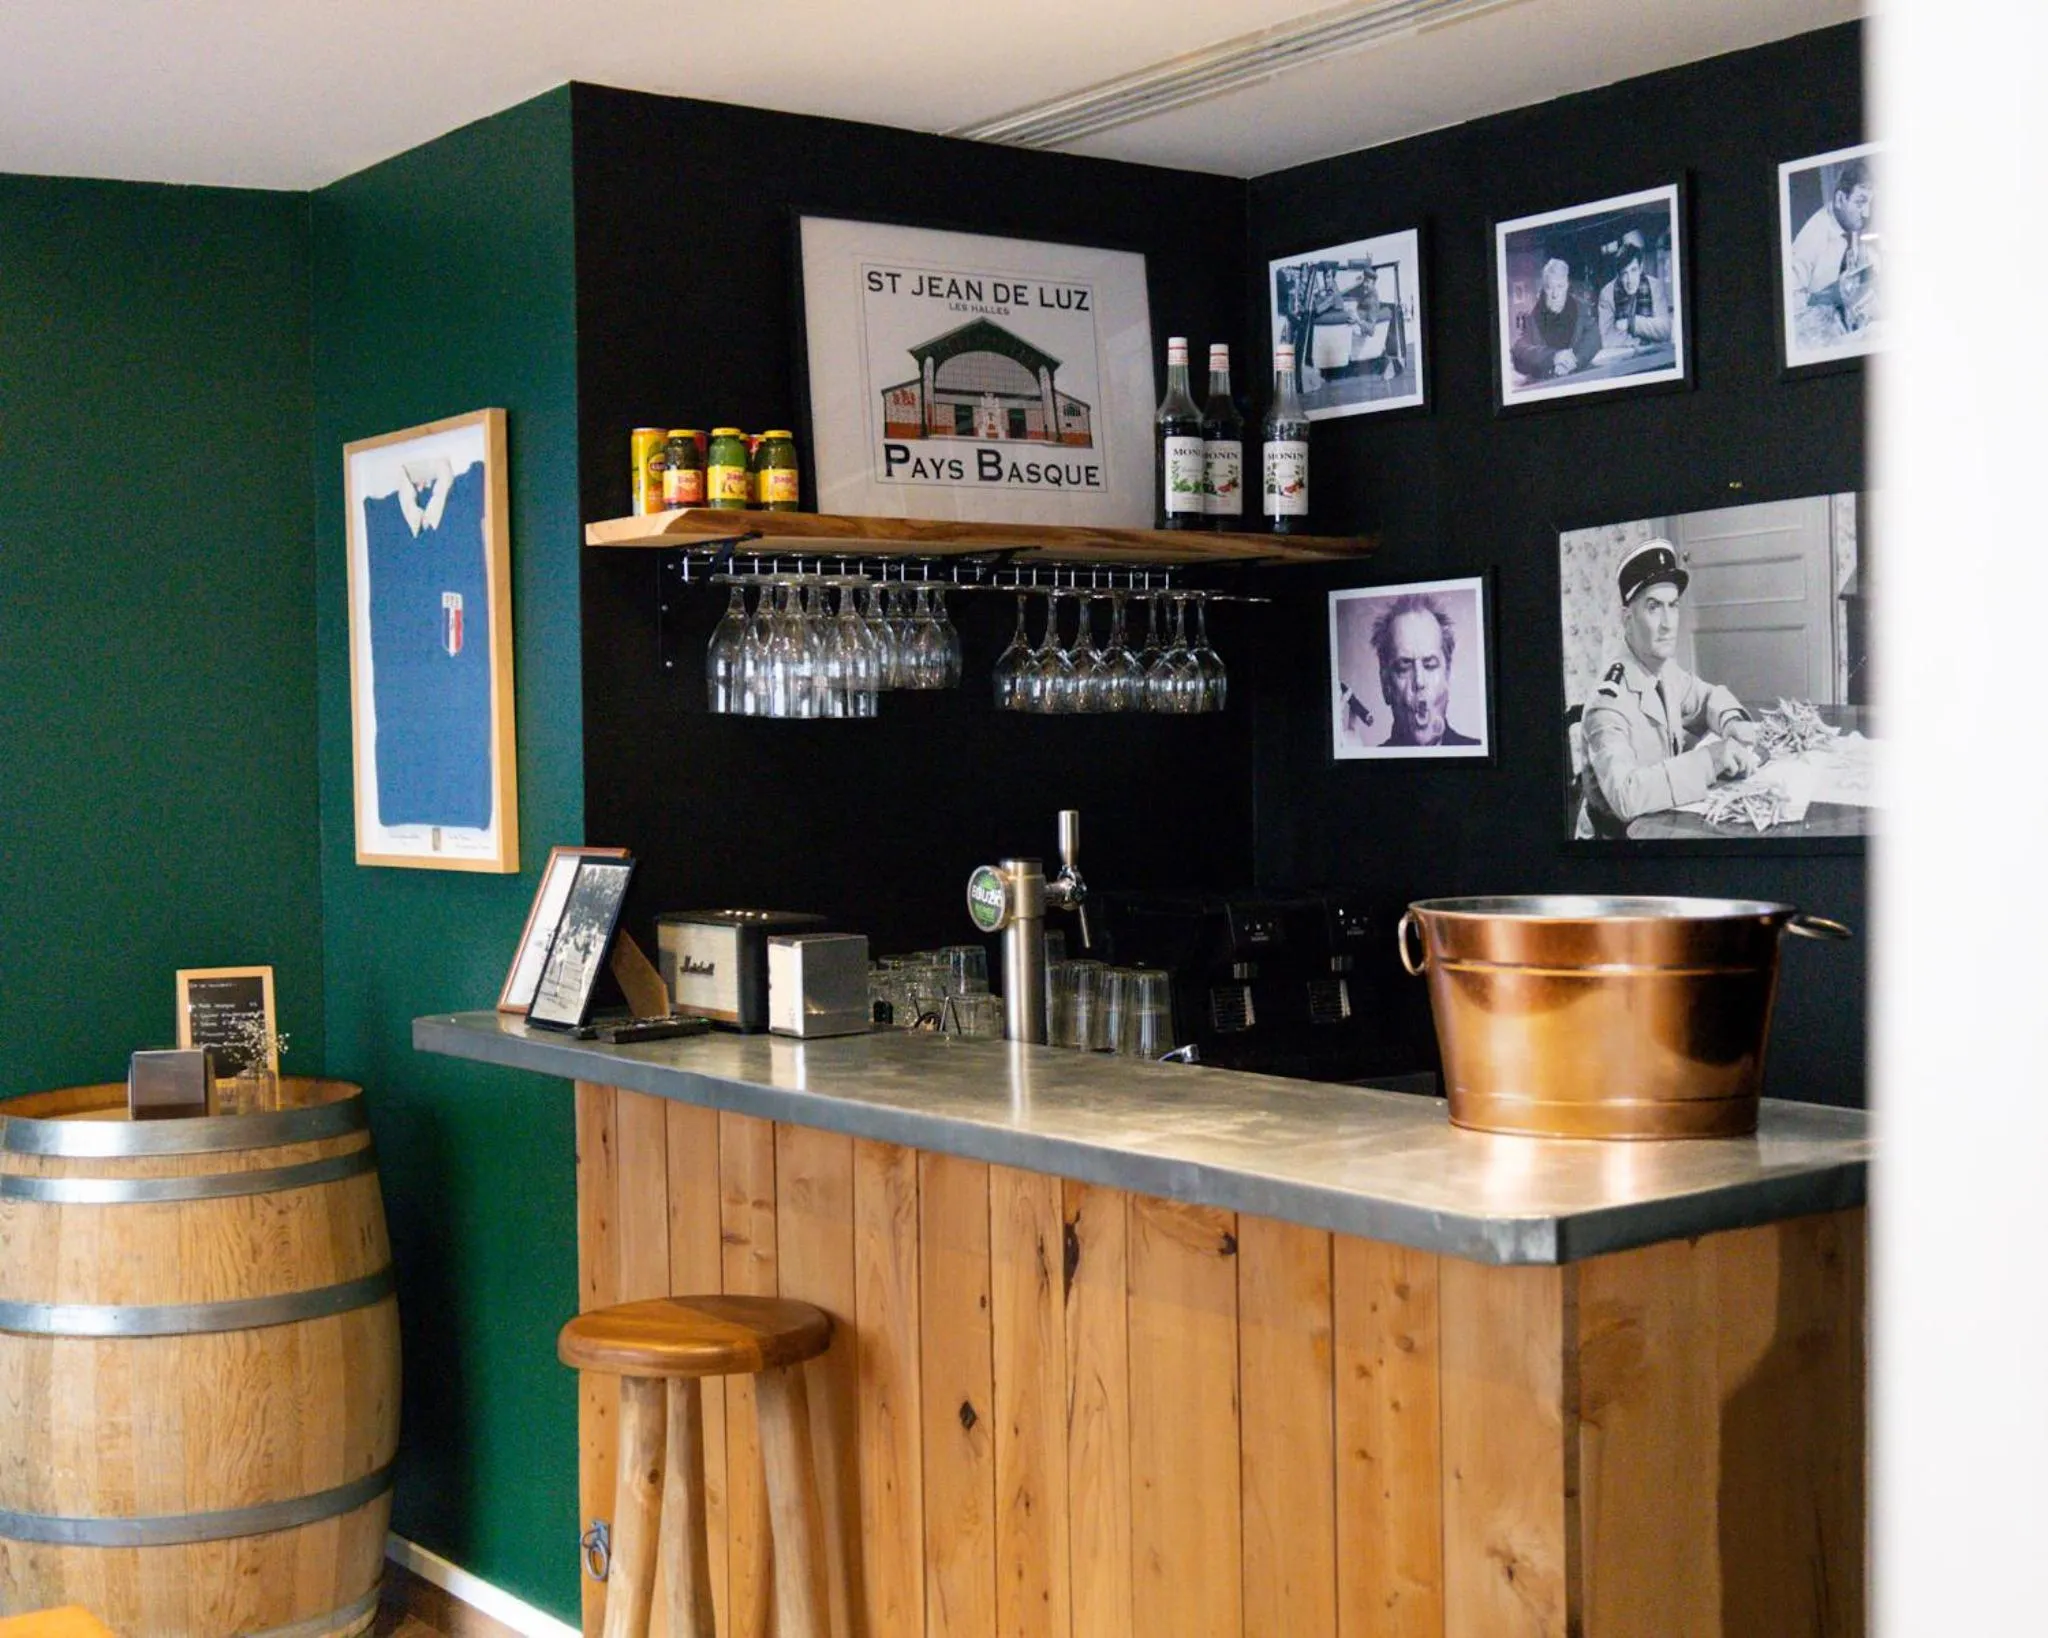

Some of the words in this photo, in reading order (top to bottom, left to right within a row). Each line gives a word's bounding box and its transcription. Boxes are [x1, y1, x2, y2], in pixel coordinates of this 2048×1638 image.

[866, 270, 902, 294] ST
[911, 275, 984, 302] JEAN
[993, 282, 1029, 306] DE
[1039, 287, 1090, 311] LUZ
[948, 302, 968, 312] LES
[971, 305, 1010, 316] HALLES
[1173, 447, 1203, 457] MONI
[1267, 451, 1305, 461] MONIN
